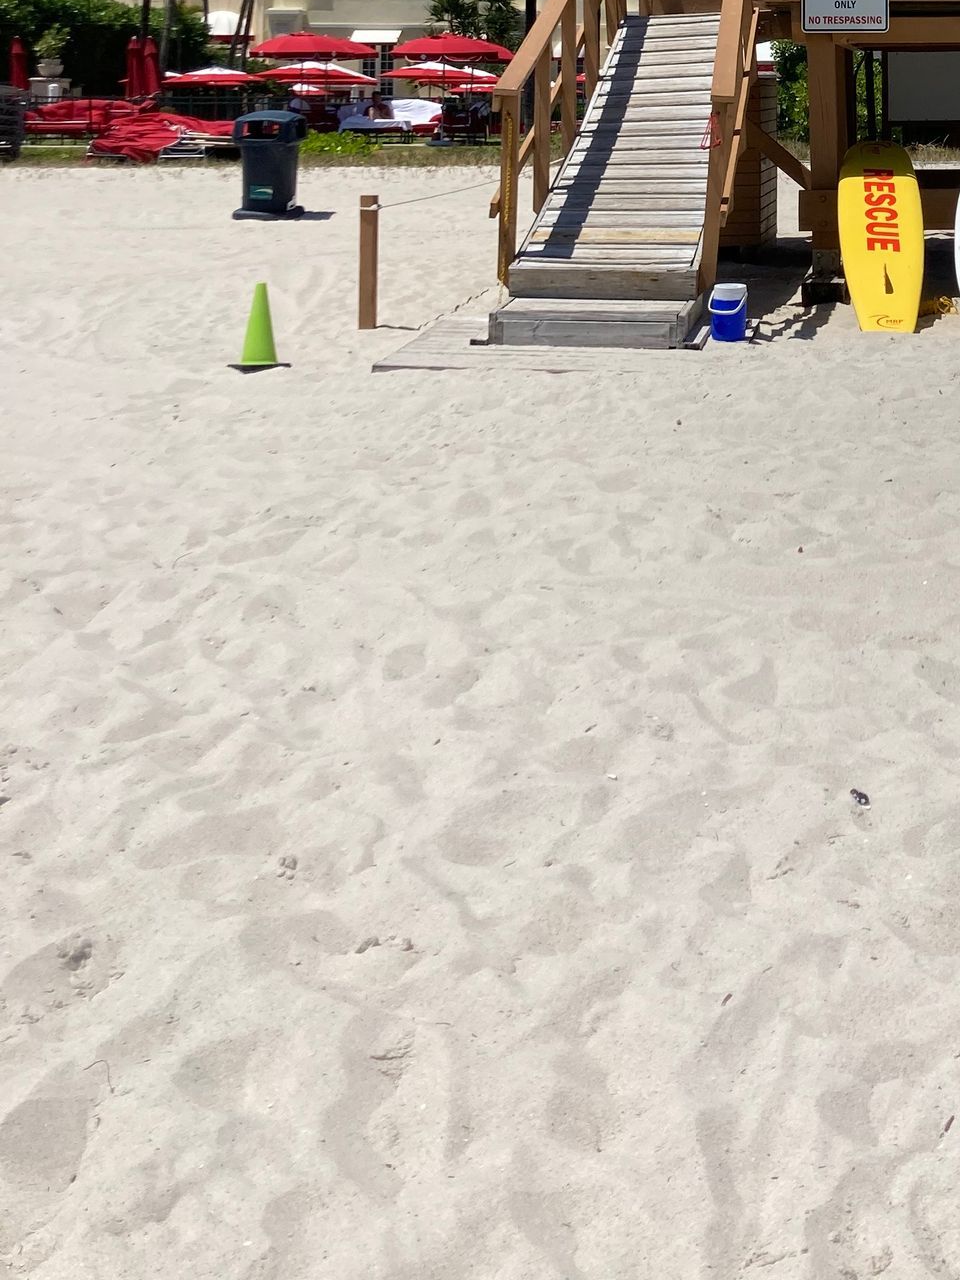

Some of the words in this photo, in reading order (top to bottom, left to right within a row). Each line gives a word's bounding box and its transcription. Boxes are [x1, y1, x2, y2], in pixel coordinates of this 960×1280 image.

[834, 0, 857, 9] ONLY
[808, 16, 821, 25] NO
[822, 16, 883, 25] TRESPASSING
[863, 168, 901, 253] RESCUE
